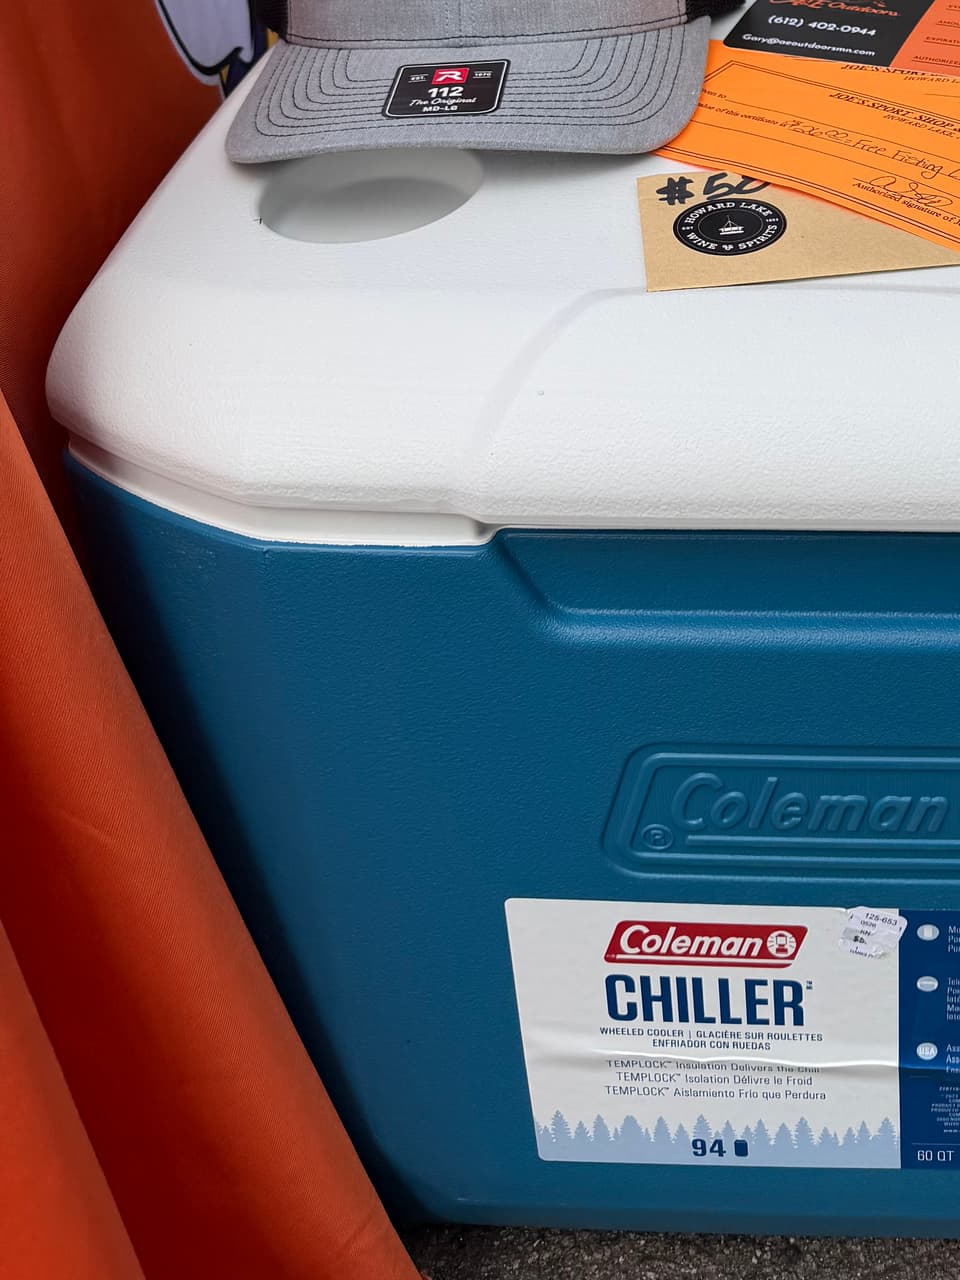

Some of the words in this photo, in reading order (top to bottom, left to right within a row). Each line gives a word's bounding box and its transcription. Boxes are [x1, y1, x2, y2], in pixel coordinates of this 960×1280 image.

[827, 1, 899, 18] Outdoors
[767, 14, 805, 29] (612)
[807, 20, 877, 37] 402-0944
[427, 86, 465, 98] 112
[408, 99, 429, 107] The
[430, 96, 478, 106] Original
[828, 91, 867, 105] JOE'S
[868, 99, 914, 117] SPORT
[914, 113, 955, 130] SHOP
[883, 113, 928, 129] HOWARD
[851, 180, 902, 203] Authorized
[901, 196, 942, 218] signature
[942, 213, 955, 223] of
[684, 201, 736, 224] HOWARD
[738, 201, 774, 218] LAKE
[686, 231, 719, 251] WINE
[737, 224, 778, 250] SPIRITS
[672, 771, 951, 834] Coleman
[619, 924, 764, 958] Coleman
[604, 973, 806, 1027] CHILLER
[599, 1026, 645, 1038] WHEELED
[646, 1028, 685, 1039] COOLER
[695, 1028, 743, 1041] GLACIÈRE
[744, 1031, 765, 1041] SUR
[766, 1031, 824, 1043] ROULETTES
[652, 1038, 708, 1050] ENFRIADOR
[708, 1040, 730, 1051] CON
[731, 1040, 772, 1052] RUEDAS
[675, 1061, 728, 1072] Insulation
[684, 1073, 731, 1085] Isolation
[732, 1073, 771, 1086] Délivre
[772, 1075, 784, 1086] le
[785, 1075, 813, 1086] Froid
[672, 1087, 736, 1099] Aislamiento
[761, 1090, 782, 1102] que
[784, 1089, 827, 1101] Perdura
[691, 1137, 728, 1158] 94
[916, 1149, 934, 1163] 60
[936, 1149, 956, 1163] QT
